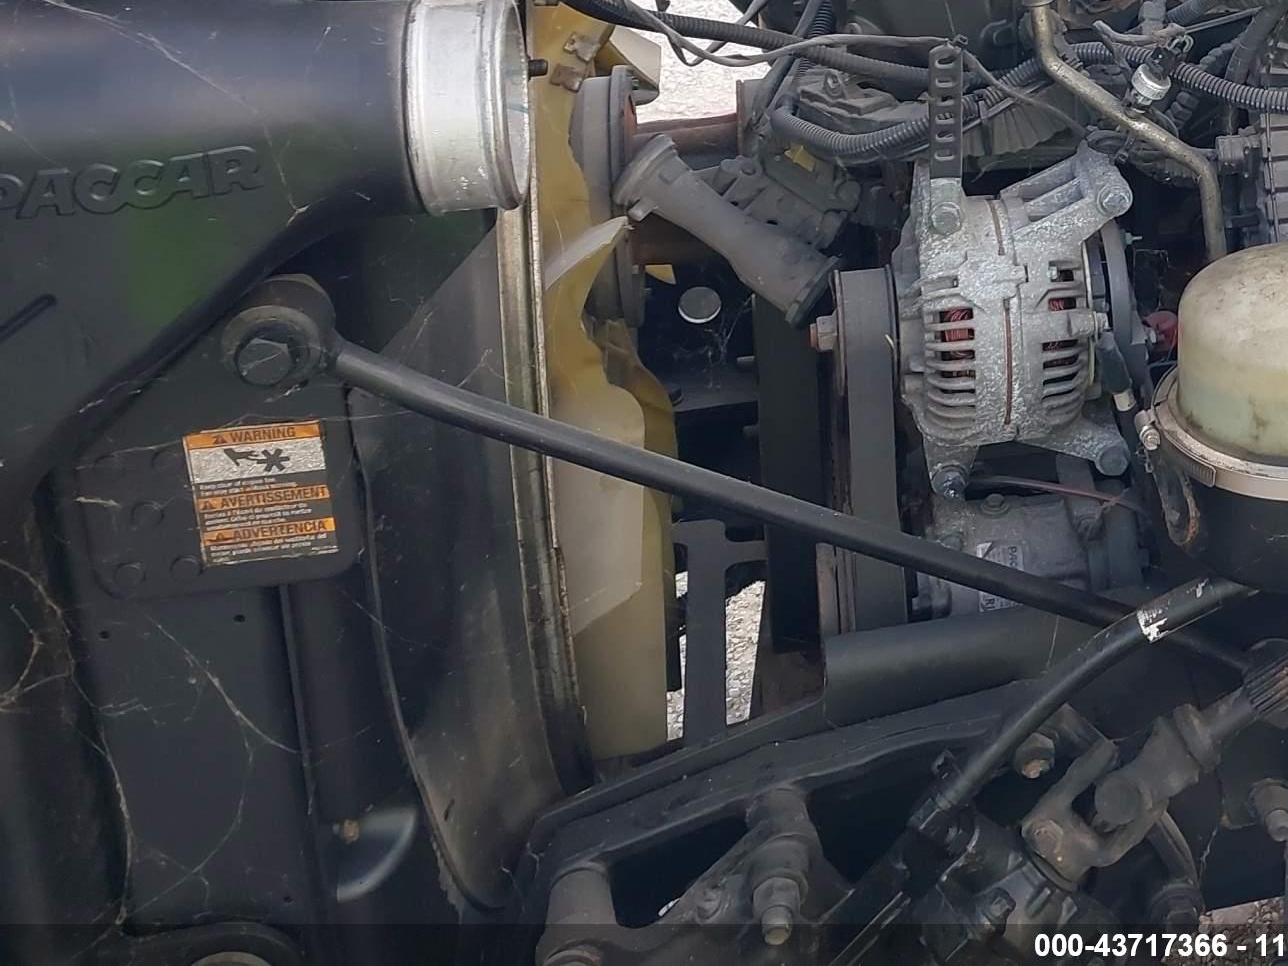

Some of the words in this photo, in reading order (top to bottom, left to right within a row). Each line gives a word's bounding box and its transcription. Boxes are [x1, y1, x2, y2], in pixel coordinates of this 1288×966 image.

[229, 426, 296, 444] WARNING
[220, 485, 327, 509] AVERTISSEMENT
[232, 521, 328, 541] ADVERTENCIA
